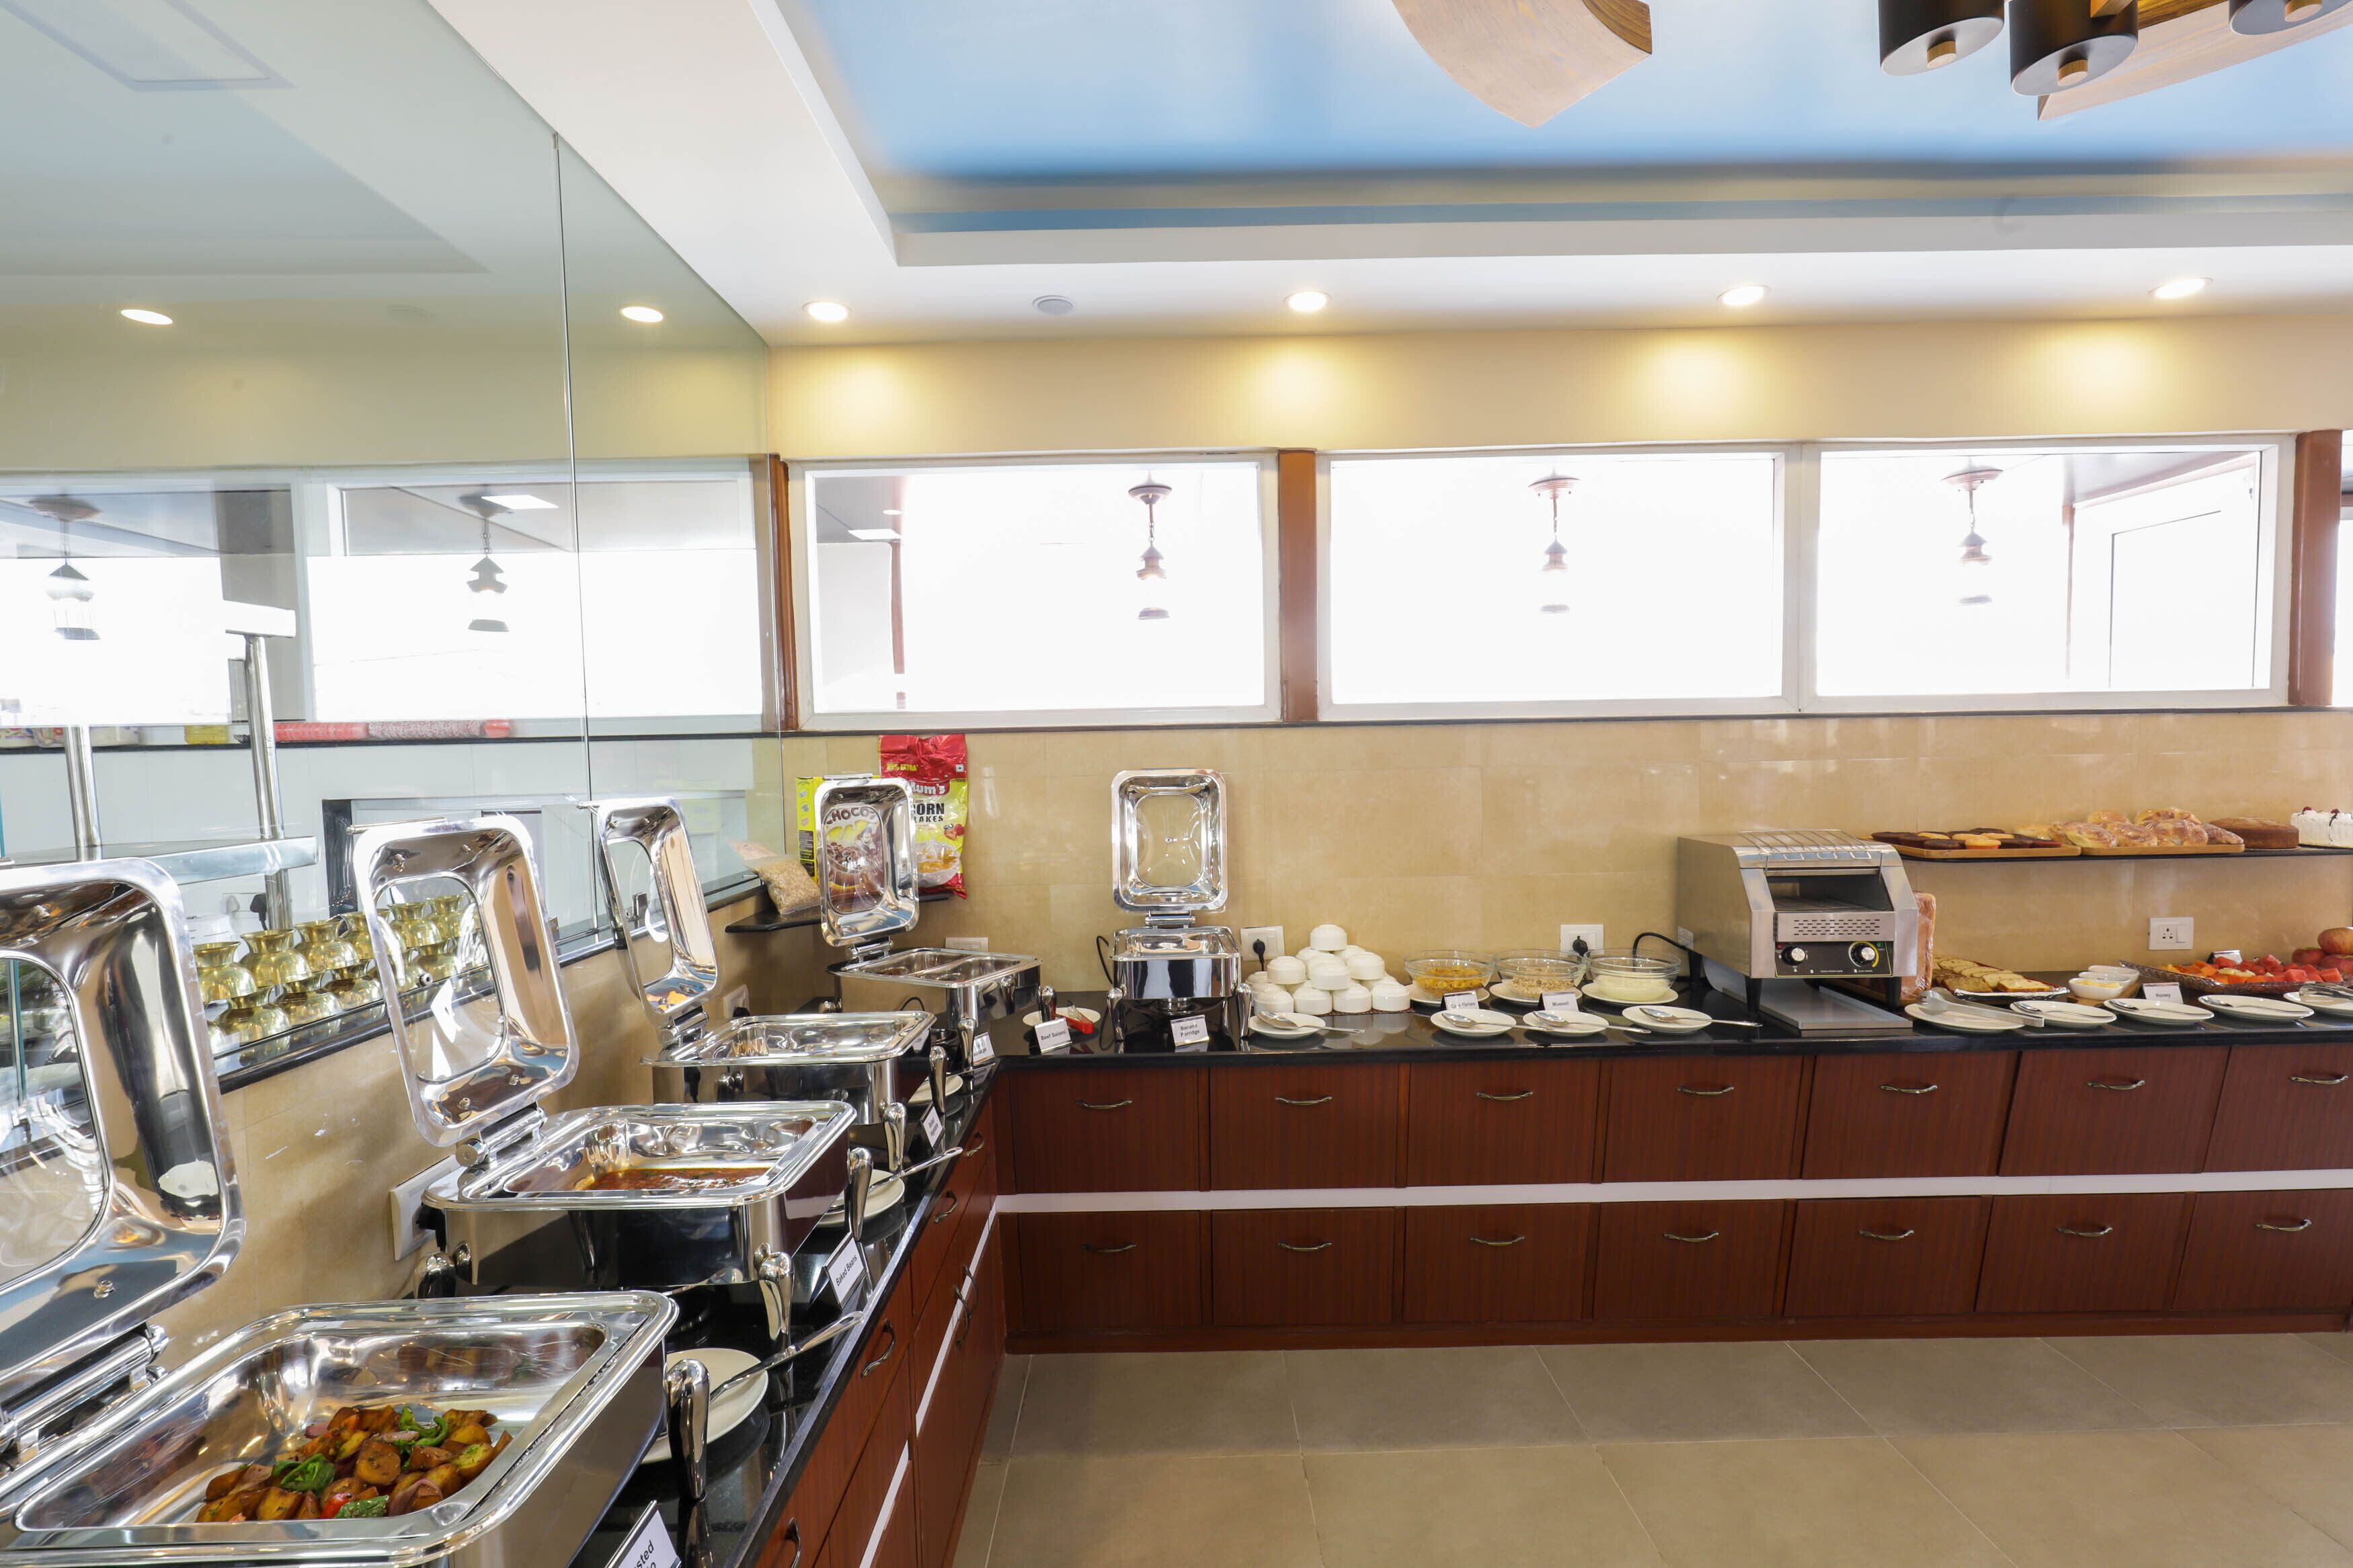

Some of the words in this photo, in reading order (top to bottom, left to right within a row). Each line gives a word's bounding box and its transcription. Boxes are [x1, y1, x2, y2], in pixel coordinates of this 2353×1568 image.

[913, 803, 945, 815] ORN
[914, 815, 944, 823] LAKES
[836, 1267, 847, 1286] Baked
[846, 1255, 858, 1272] Beans
[634, 1539, 654, 1568] sted
